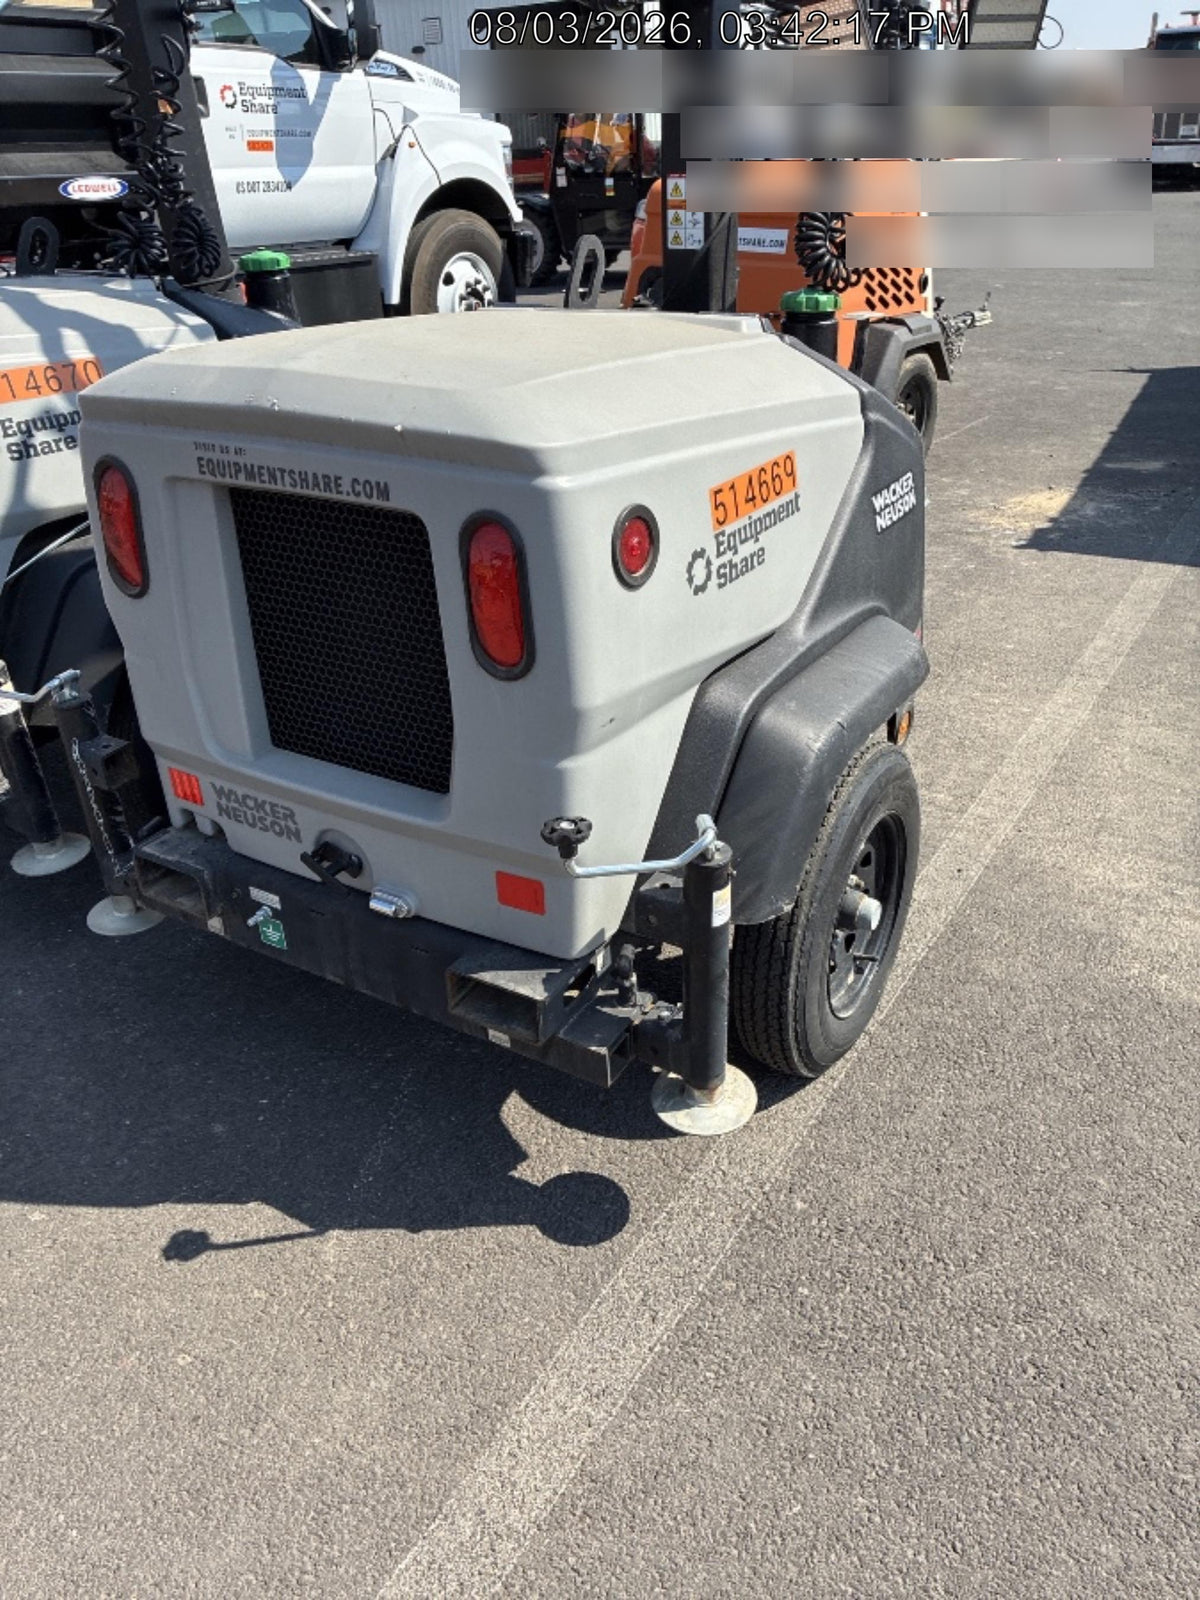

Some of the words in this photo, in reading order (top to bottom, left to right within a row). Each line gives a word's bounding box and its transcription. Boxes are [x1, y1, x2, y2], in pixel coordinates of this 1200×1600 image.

[238, 82, 308, 99] Equipment
[241, 99, 279, 115] Share
[72, 184, 118, 193] LEDWELL
[6, 434, 79, 461] Share
[196, 456, 391, 502] EQUIPMENTSHARE.COM
[713, 454, 797, 526] 514669
[870, 470, 915, 513] WACKER
[713, 491, 802, 559] Equipment
[875, 489, 917, 533] NEUSON
[716, 546, 766, 590] Share
[209, 781, 299, 826] WACKER
[216, 800, 303, 844] NEUSON
